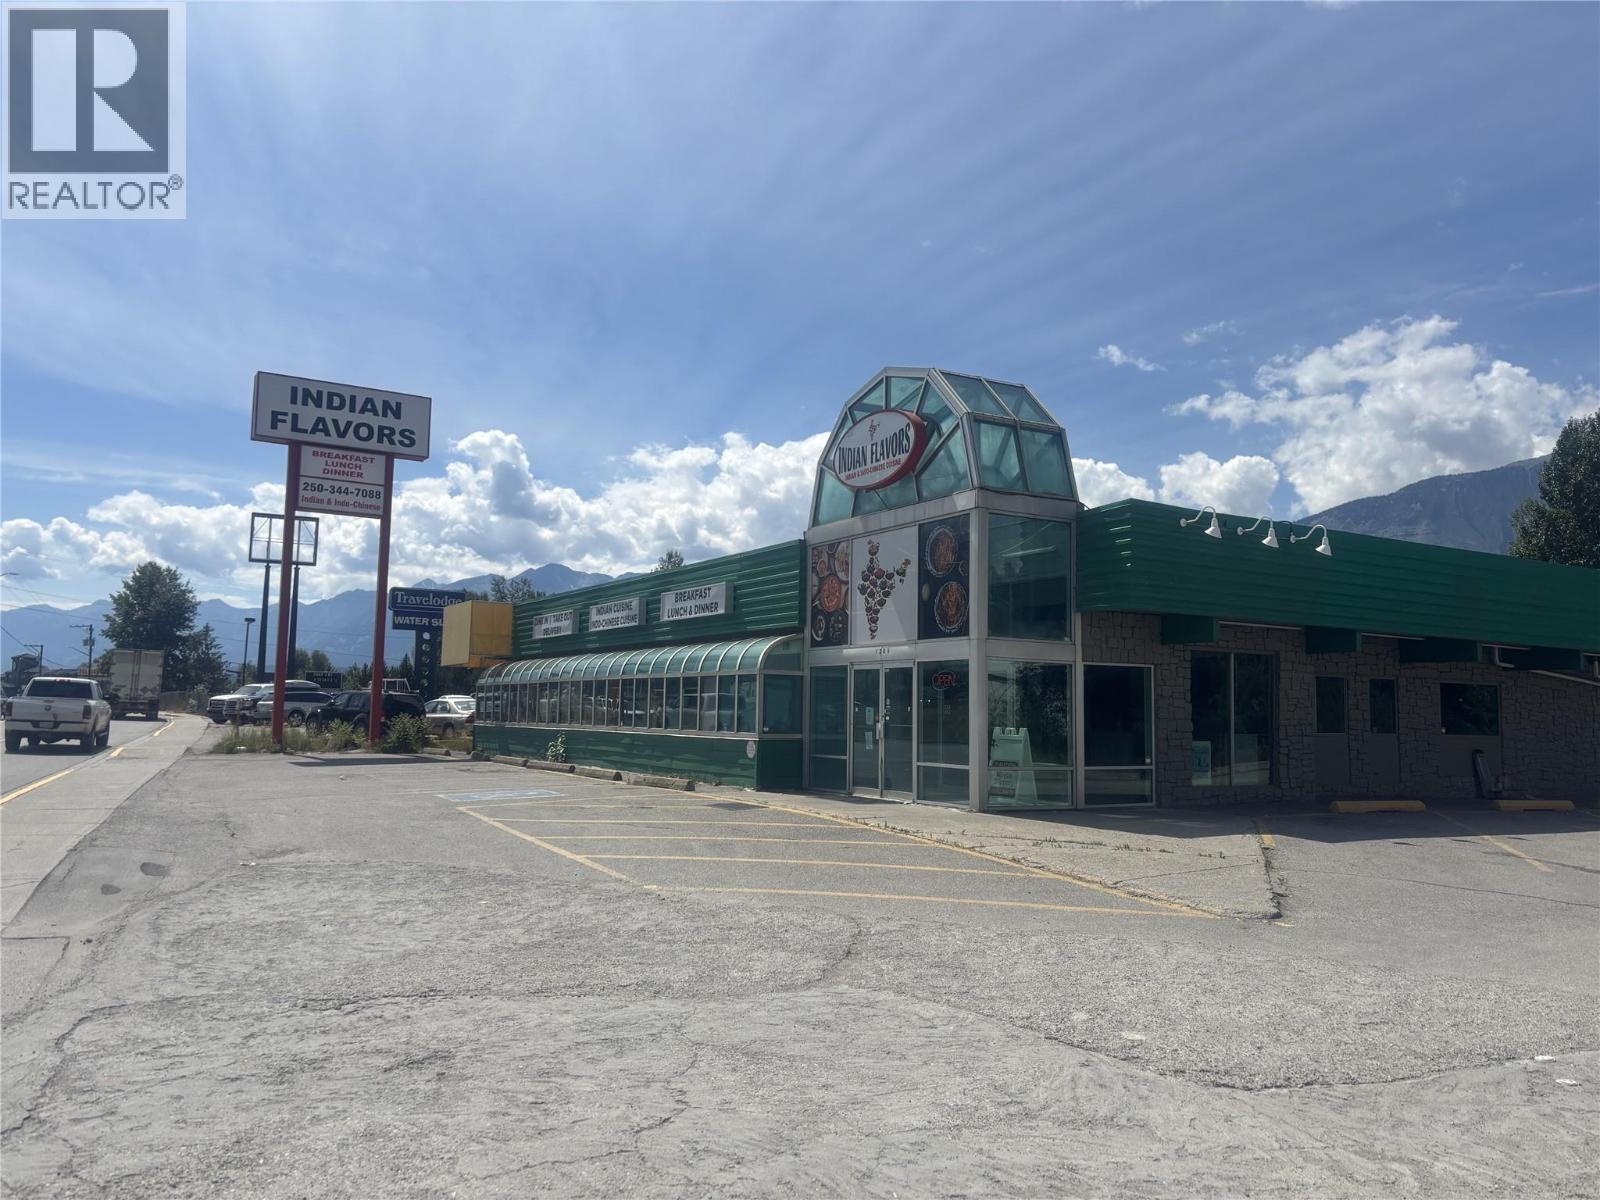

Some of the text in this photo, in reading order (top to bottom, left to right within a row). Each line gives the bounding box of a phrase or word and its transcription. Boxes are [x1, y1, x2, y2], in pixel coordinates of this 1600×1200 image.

[290, 386, 402, 420] INDIAN
[270, 410, 416, 448] FLAVORS
[838, 422, 911, 474] INDIAN FLAVORS
[312, 450, 376, 464] BREAKFAST
[325, 460, 362, 471] LUNCH
[322, 468, 364, 479] DINNER
[302, 481, 382, 500] 250-344-7088
[301, 495, 325, 505] Indian
[327, 497, 332, 506] &
[394, 591, 463, 606] Travelodge
[674, 587, 712, 603] BREAKFAST
[596, 601, 633, 616] INDIAN CUISINE
[667, 602, 719, 618] LUNCH & DINNER
[394, 616, 430, 626] WATER
[620, 614, 638, 626] CUISINE
